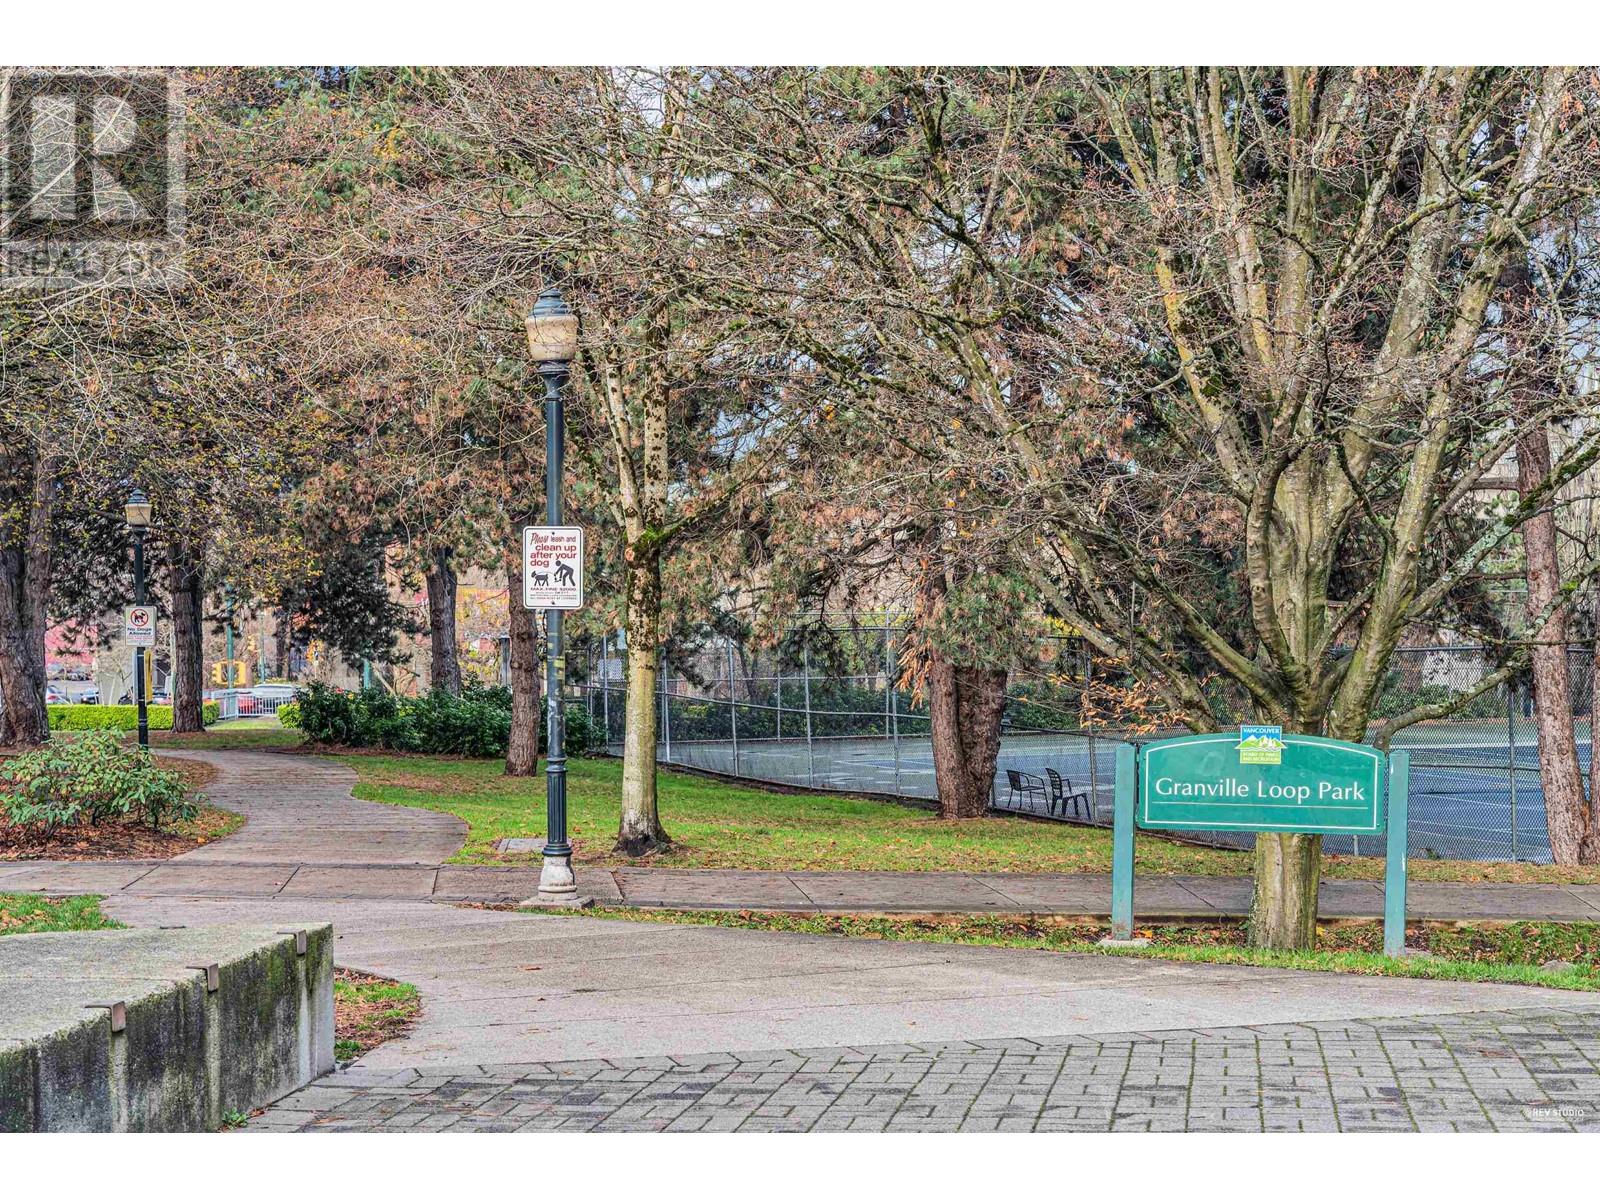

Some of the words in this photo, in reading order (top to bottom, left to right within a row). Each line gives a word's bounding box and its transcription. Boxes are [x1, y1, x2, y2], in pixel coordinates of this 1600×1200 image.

[535, 543, 562, 552] clean
[564, 545, 577, 553] up
[530, 551, 553, 559] after
[555, 552, 577, 561] your
[530, 559, 550, 568] dog
[1155, 777, 1249, 798] Granville
[1257, 780, 1311, 804] Loop
[1318, 782, 1365, 801] Park
